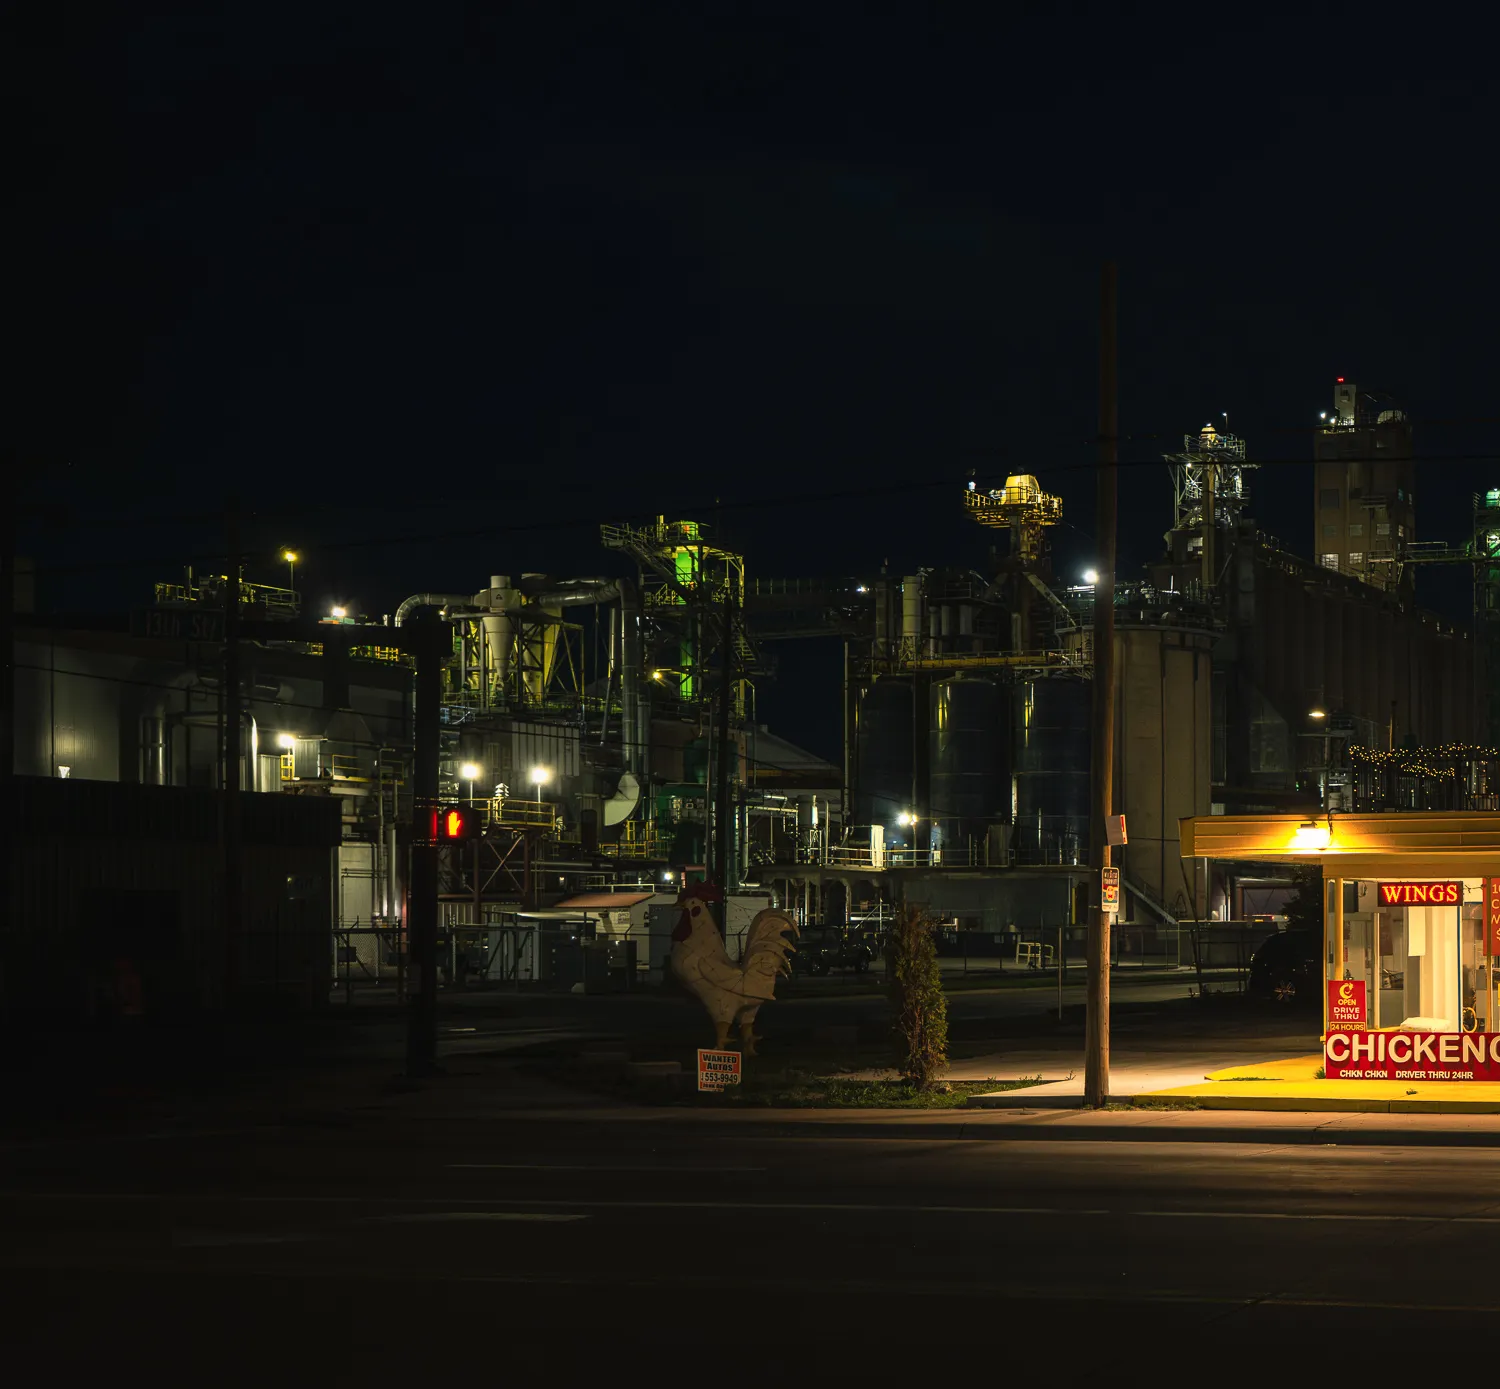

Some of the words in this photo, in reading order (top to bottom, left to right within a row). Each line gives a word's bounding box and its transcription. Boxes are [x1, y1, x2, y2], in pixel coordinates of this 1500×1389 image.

[1382, 884, 1458, 903] WINGS
[1333, 1006, 1360, 1014] DRIVE
[1331, 1023, 1340, 1031] 24
[703, 1054, 736, 1063] WANTED
[707, 1063, 732, 1071] AUTOS
[1339, 1069, 1363, 1078] CHKN
[1364, 1070, 1388, 1079] CHKN
[1395, 1070, 1427, 1079] DRIVER
[1427, 1071, 1451, 1080] THRU
[1452, 1071, 1474, 1080] 24HR
